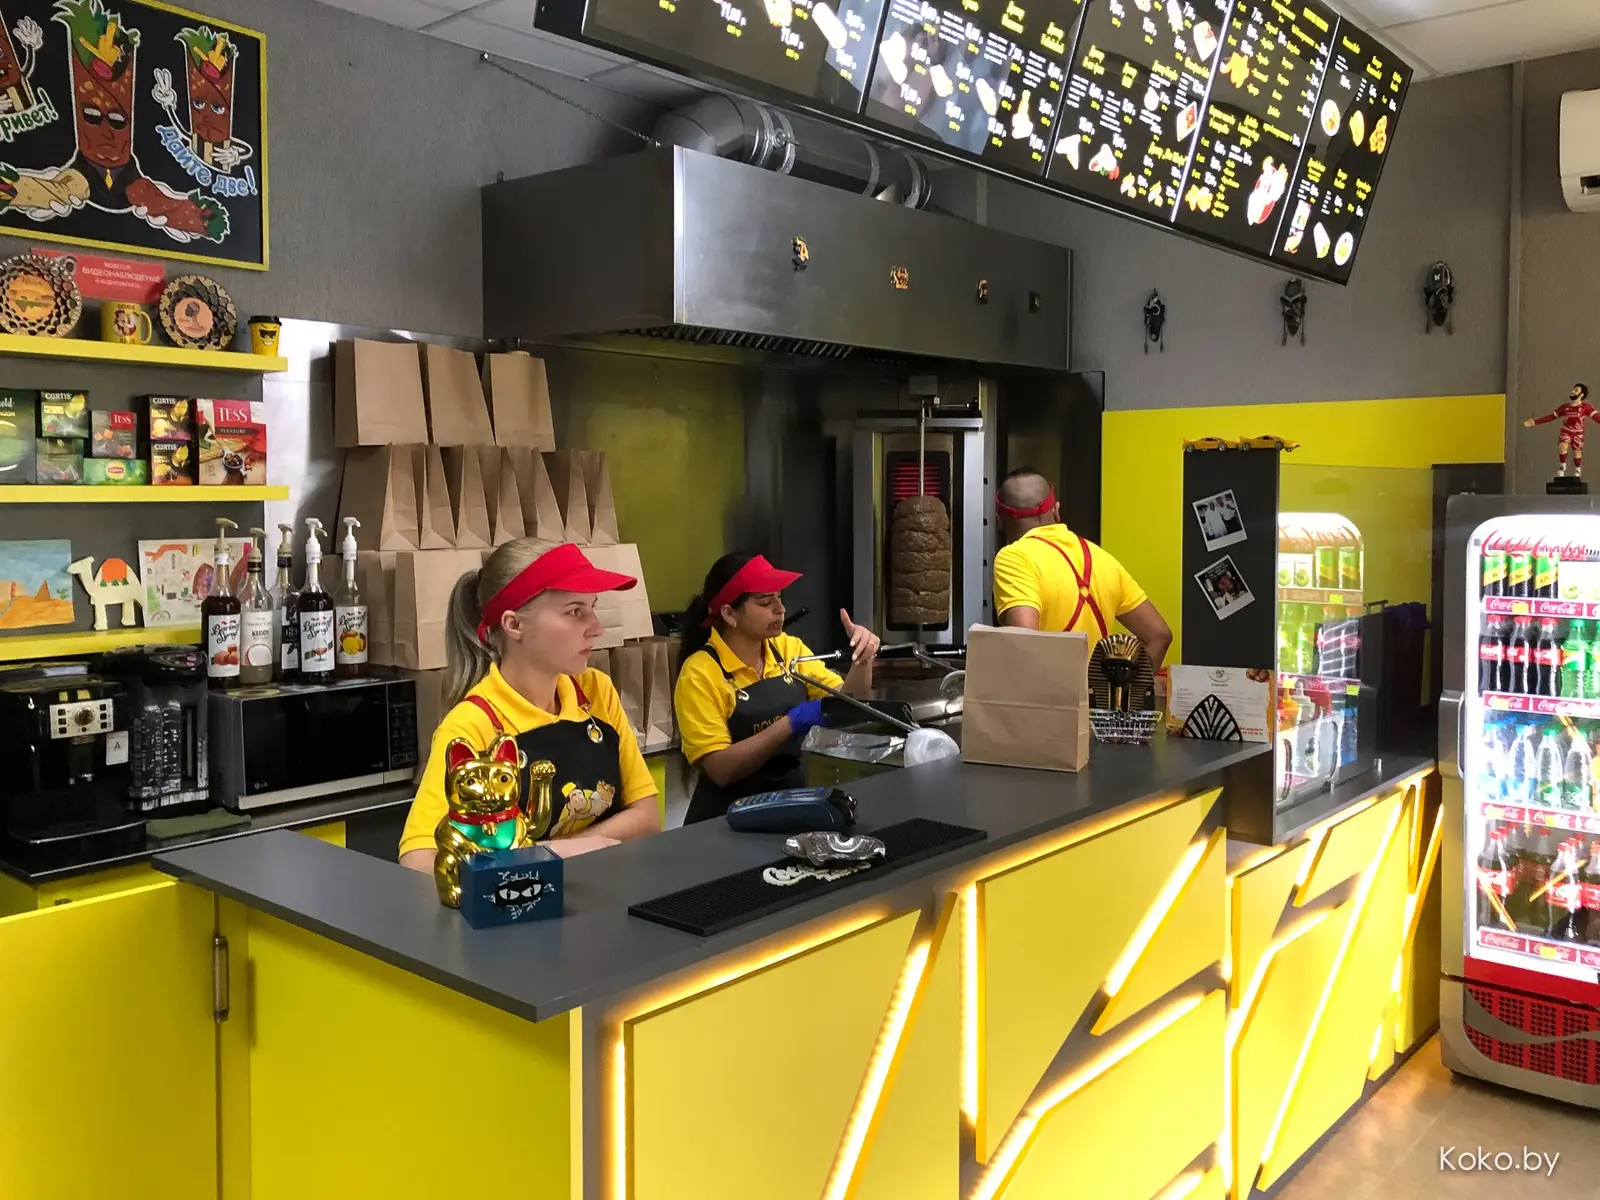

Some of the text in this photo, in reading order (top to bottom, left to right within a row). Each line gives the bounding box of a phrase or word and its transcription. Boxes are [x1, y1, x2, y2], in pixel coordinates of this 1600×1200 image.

[212, 165, 258, 198] две!
[45, 392, 72, 400] CURTIS
[152, 397, 176, 405] CURTIS
[113, 414, 132, 424] TESS
[220, 407, 248, 423] TESS
[154, 443, 177, 451] CURTIS
